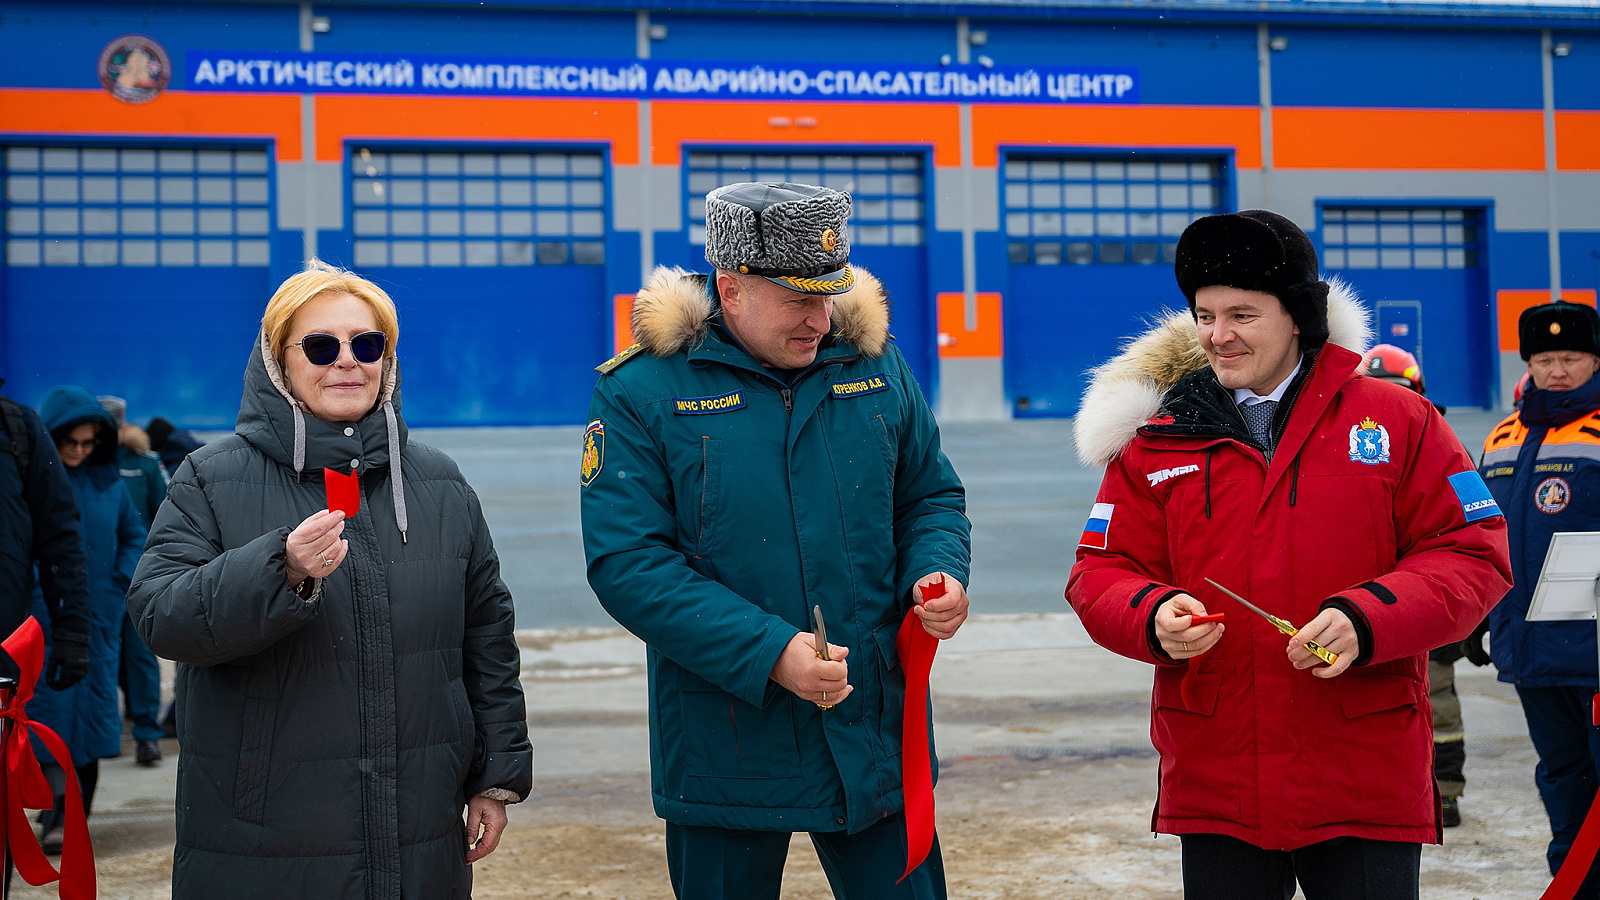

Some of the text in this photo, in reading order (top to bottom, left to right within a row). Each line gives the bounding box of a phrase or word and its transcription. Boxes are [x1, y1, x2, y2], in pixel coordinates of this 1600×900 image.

[195, 59, 1133, 100] АРКТИЧЕСКИЙ КОМПЛЕКСНЫЙ АВАРИЙНО-СПАСАТЕЛЬНЫЙ ЦЕНТР
[1371, 358, 1381, 370] 2
[868, 377, 886, 390] А.В.
[676, 393, 741, 411] МЧС РОССИИ
